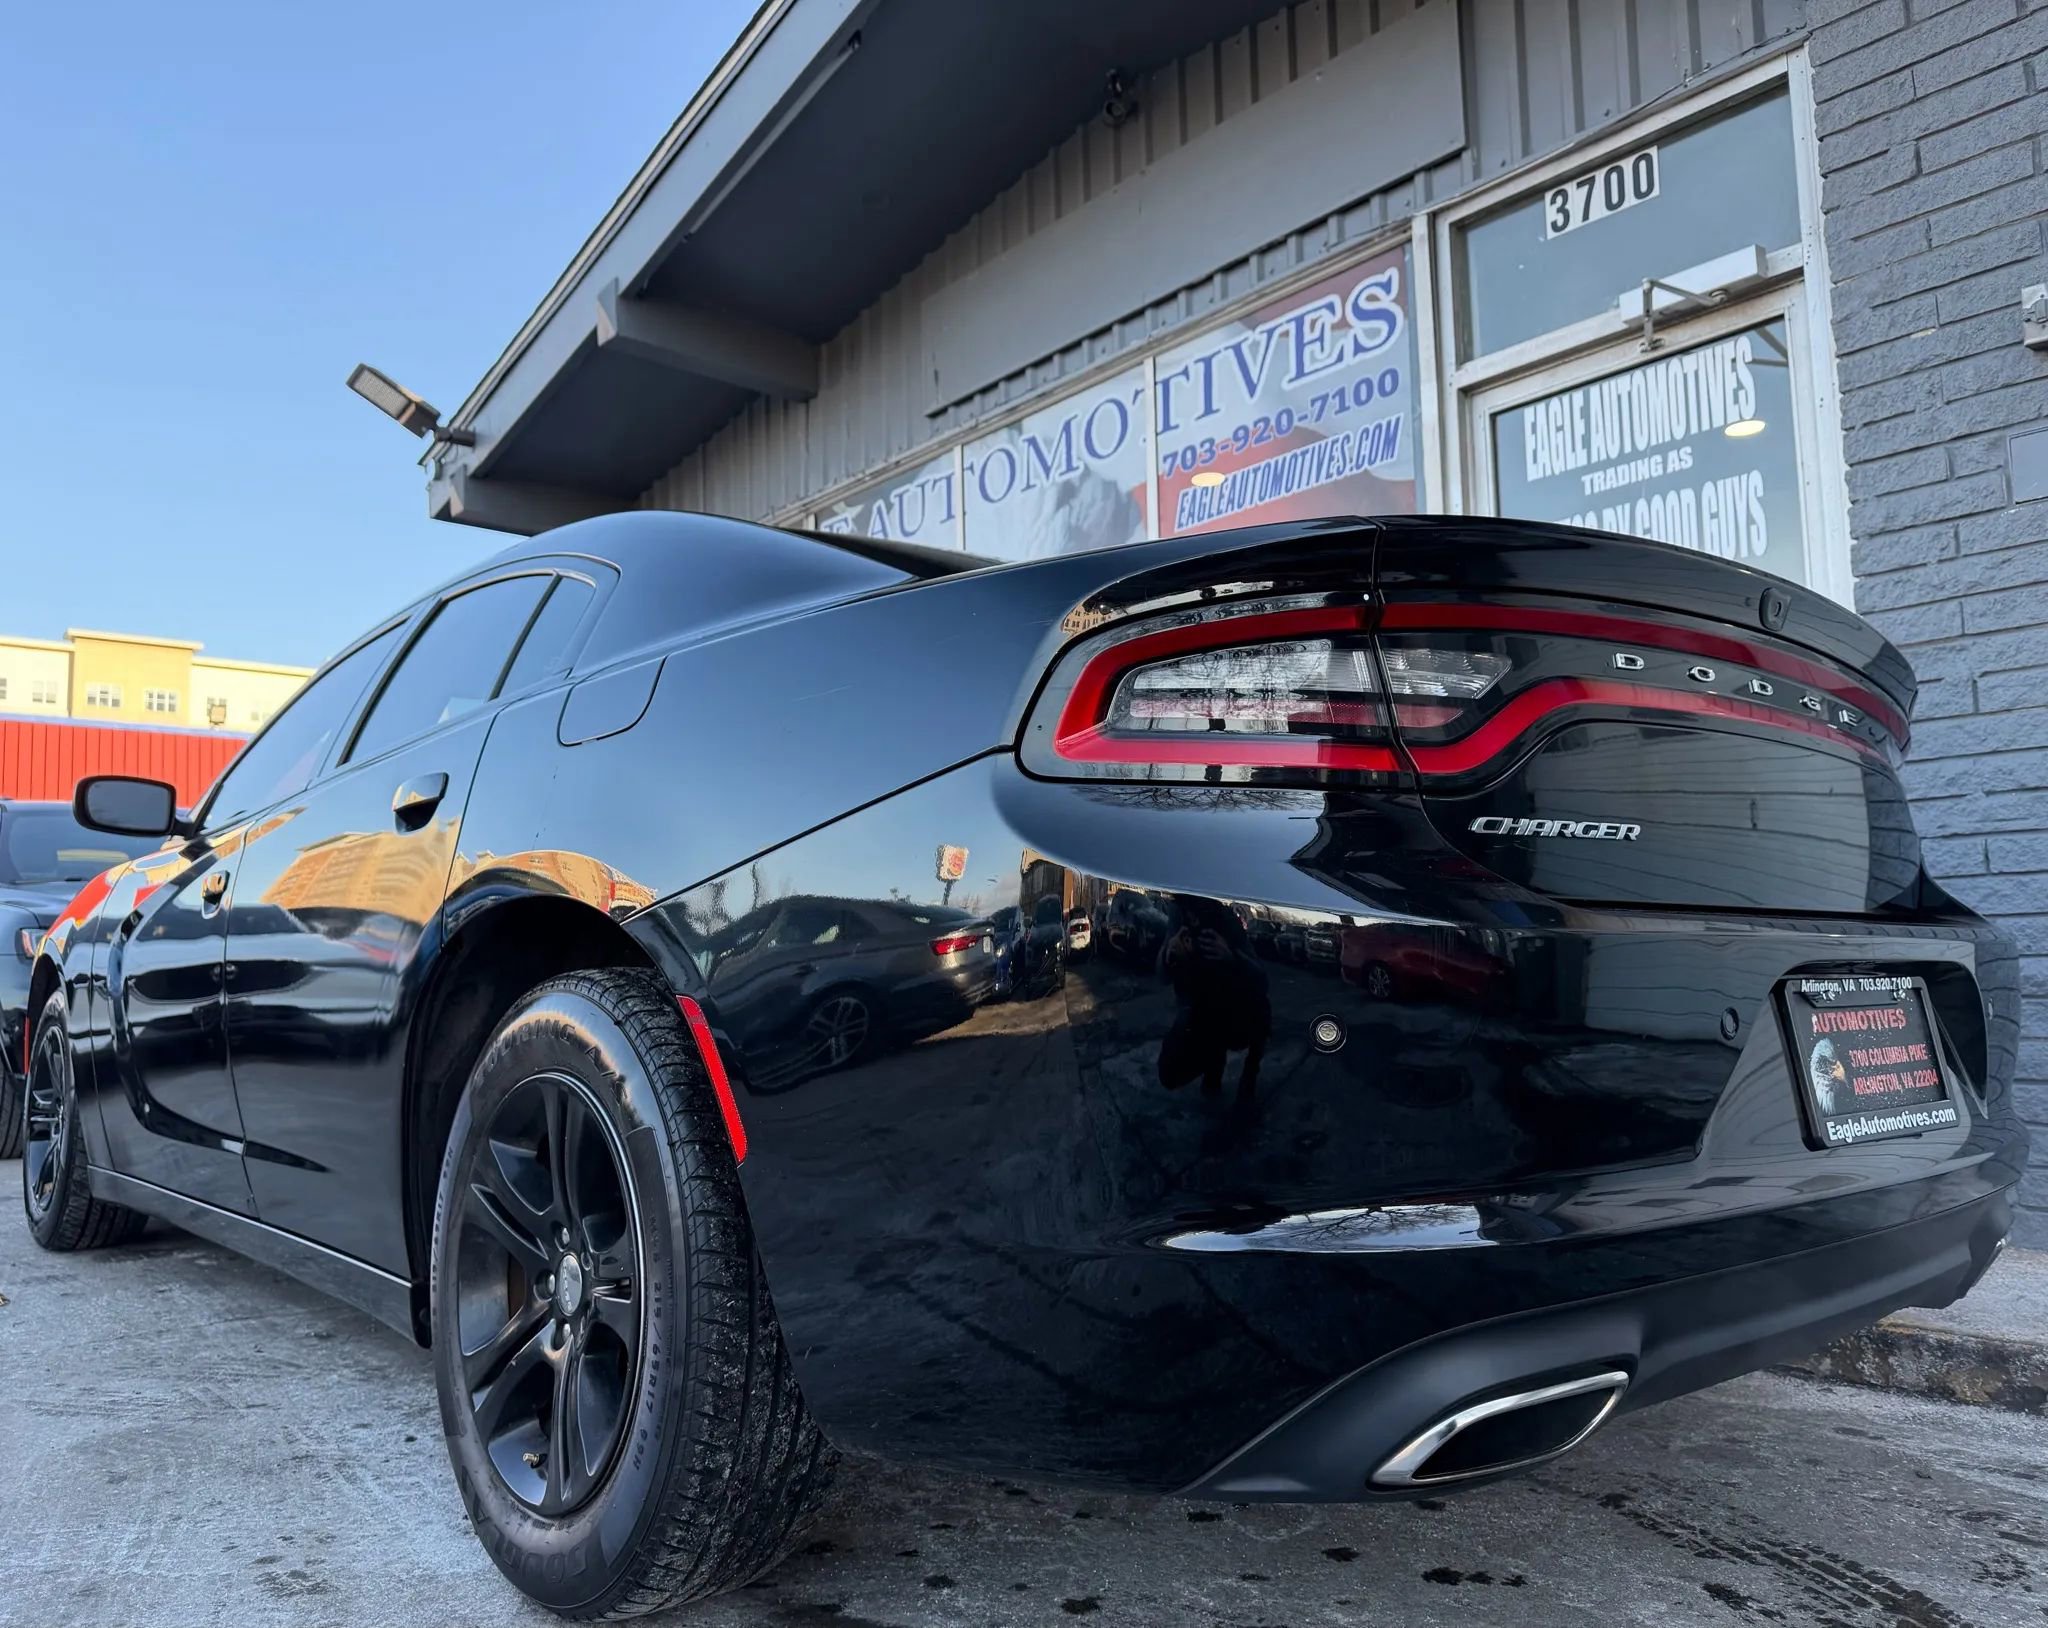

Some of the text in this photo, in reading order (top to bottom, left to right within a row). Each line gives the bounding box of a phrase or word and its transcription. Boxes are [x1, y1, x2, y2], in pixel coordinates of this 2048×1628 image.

[1550, 152, 1657, 234] 3700
[868, 269, 1401, 541] AUTOMOTIVES
[1162, 367, 1400, 478] 703-920-7100
[1523, 336, 1756, 482] EAGLE AUTOMOTIVES
[1175, 414, 1403, 531] EAGLEAUTOMOTIVES.COM
[1581, 446, 1694, 496] TRADING AS
[1701, 470, 1768, 560] GUYS
[1613, 652, 1861, 727] DODGE
[1468, 816, 1642, 841] CHARGER
[1842, 978, 1856, 992] VA
[1858, 976, 1912, 992] 703.920.7100
[1811, 1008, 1907, 1034] AUTOMOTIVES
[1868, 1045, 1909, 1065] COLUMBIA
[1901, 1071, 1916, 1089] VA
[1826, 1106, 1957, 1143] EagleAutomotives.com
